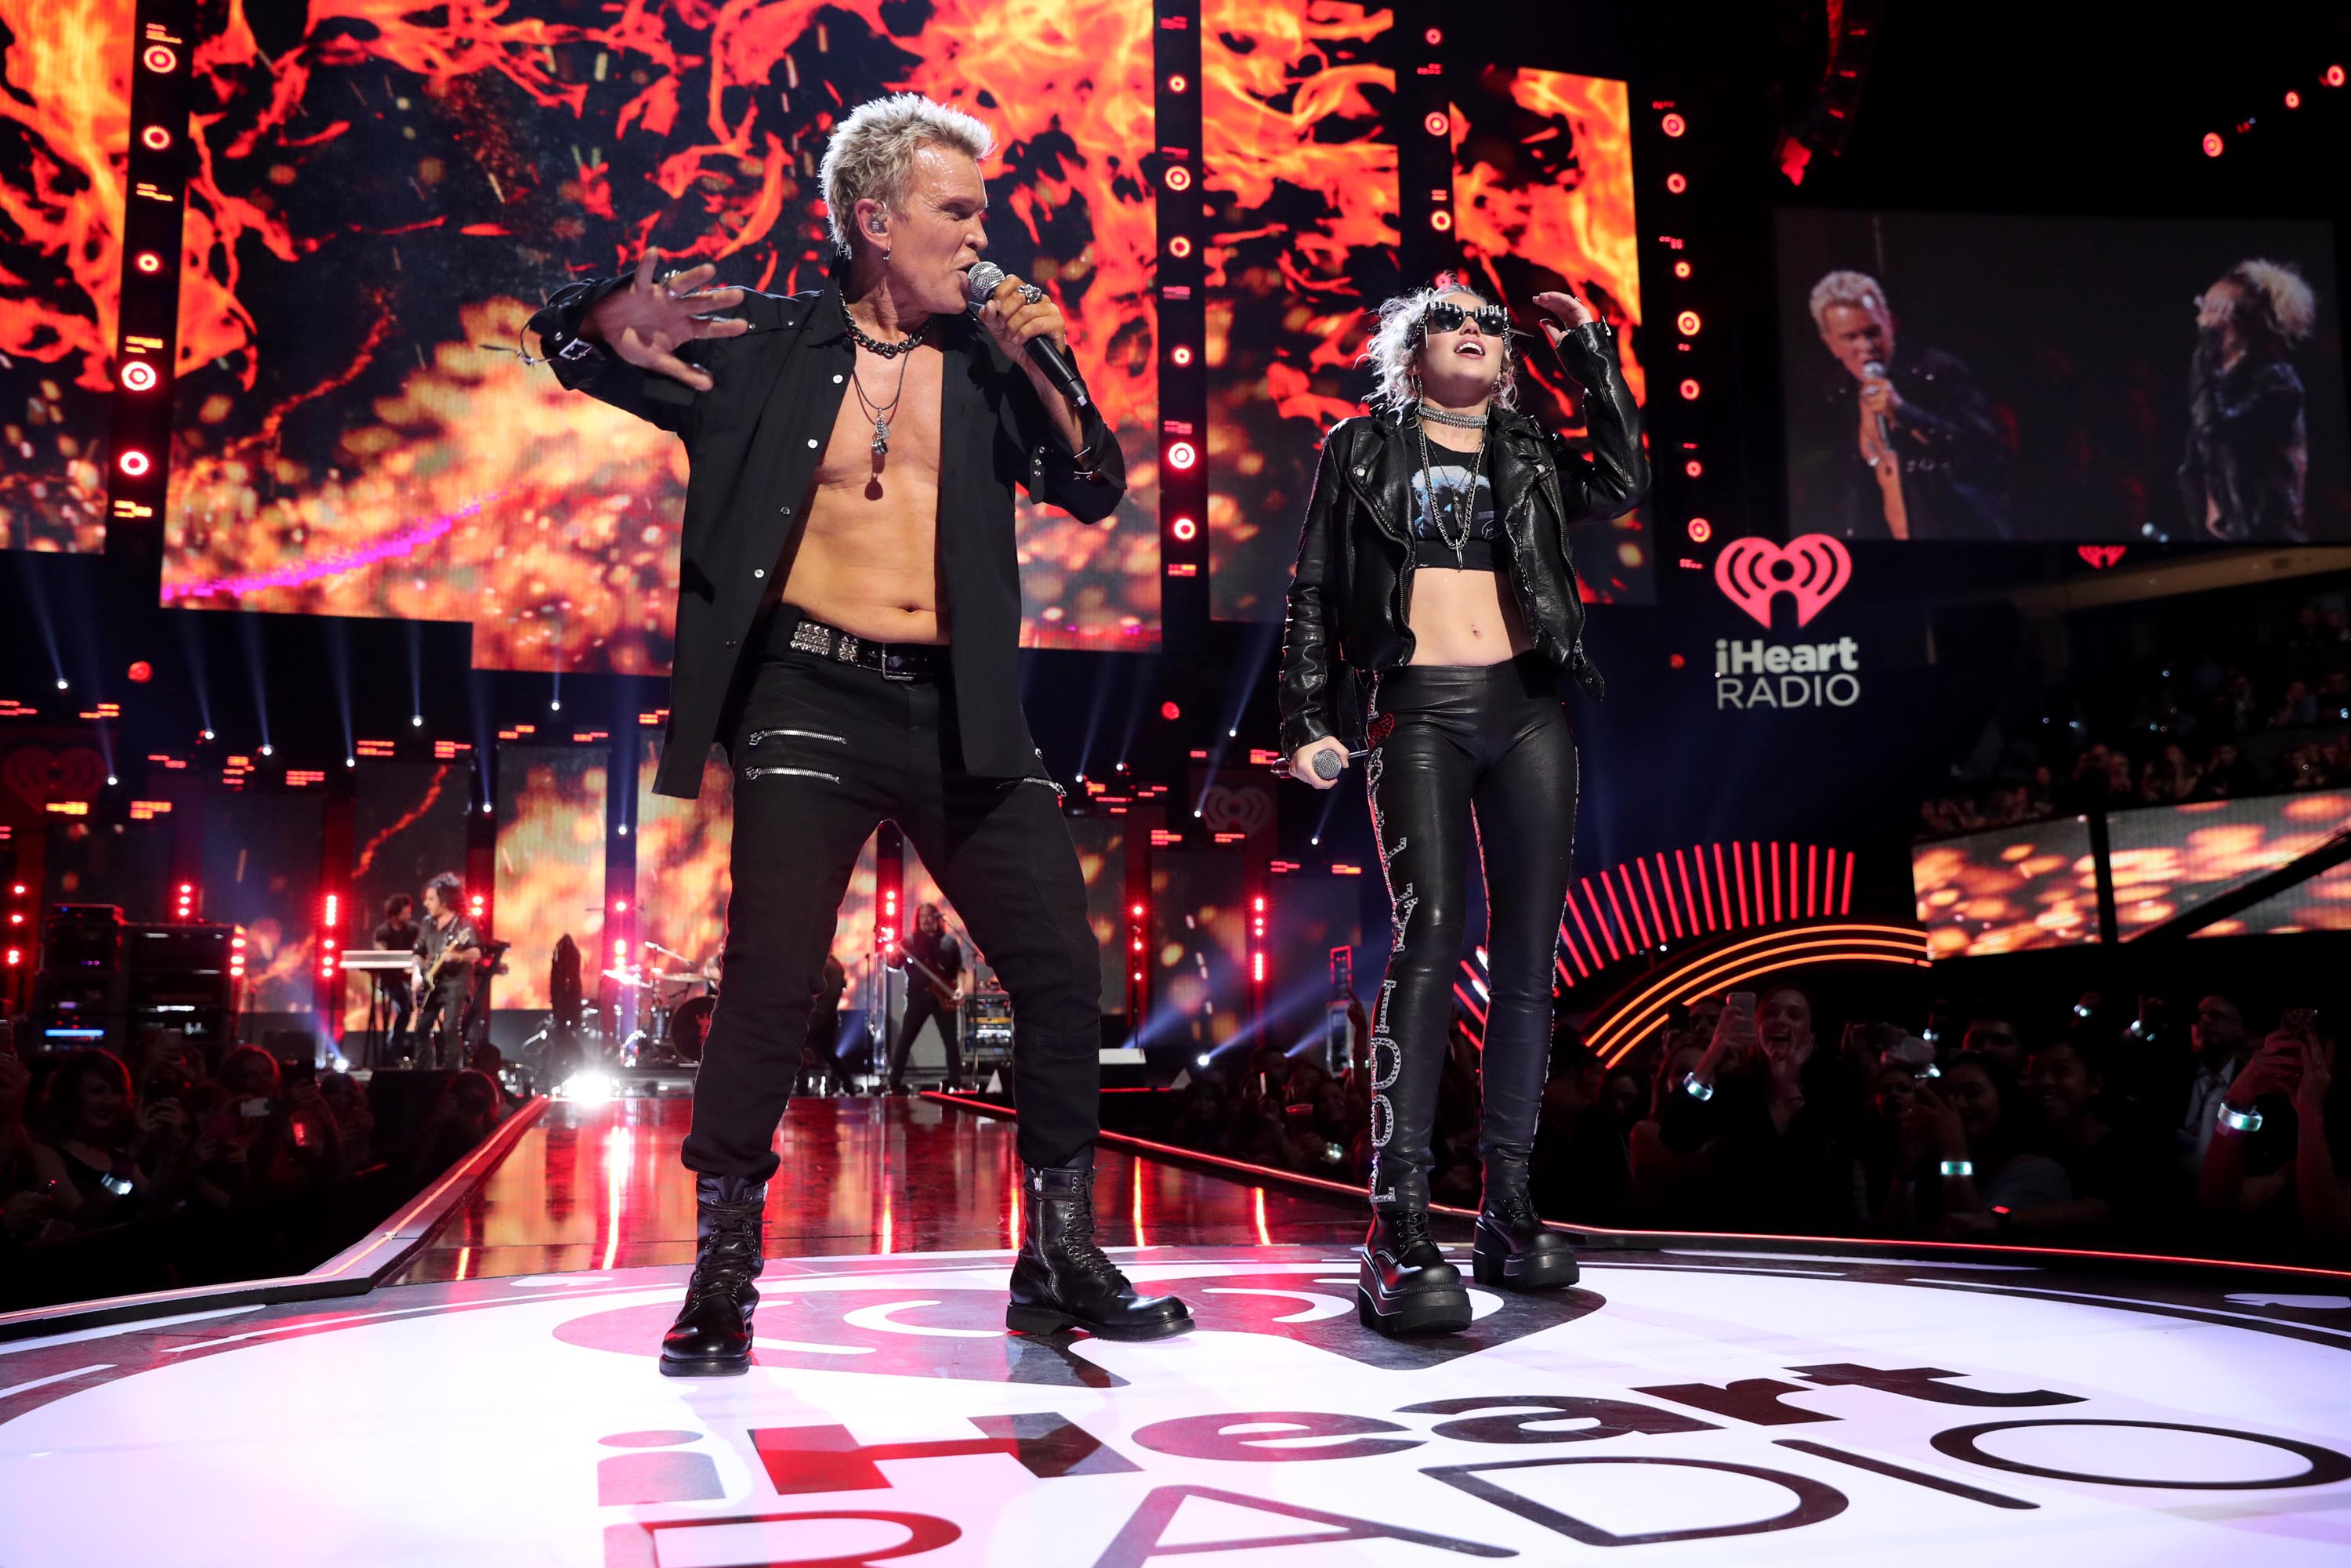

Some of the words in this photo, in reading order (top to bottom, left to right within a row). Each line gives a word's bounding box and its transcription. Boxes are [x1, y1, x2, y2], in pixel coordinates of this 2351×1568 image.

[1715, 636, 1860, 675] iHeart
[1716, 673, 1861, 710] RADIO
[1368, 979, 1402, 1204] IDOL
[597, 1363, 2091, 1507] iHeart
